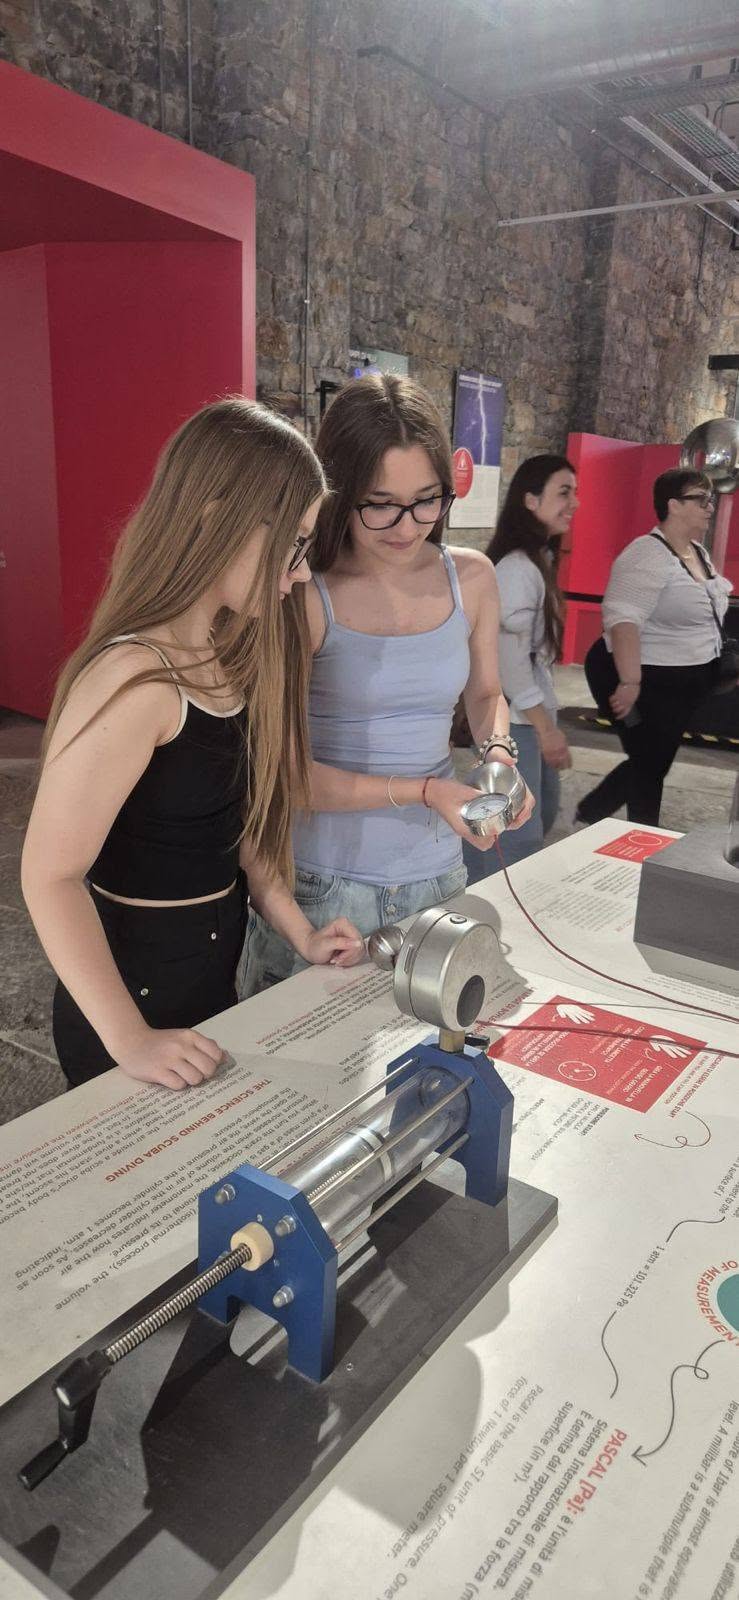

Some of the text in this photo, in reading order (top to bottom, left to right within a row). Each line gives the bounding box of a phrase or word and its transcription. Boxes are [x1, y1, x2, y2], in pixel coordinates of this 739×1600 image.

[104, 1077, 272, 1183] THE SCIENCE BEHIND SCUBA DIVING
[221, 1143, 235, 1154] the
[194, 1151, 223, 1171] volume
[162, 1169, 178, 1181] the
[174, 1175, 186, 1187] air
[185, 1169, 196, 1179] of
[193, 1172, 209, 1186] the
[131, 1178, 164, 1202] cylinder
[149, 1188, 166, 1201] the
[164, 1182, 175, 1192] in
[26, 1190, 50, 1208] body
[149, 1181, 194, 1215] manometer
[93, 1199, 132, 1227] becomes
[117, 1199, 150, 1224] cylinder
[107, 1212, 173, 1258] to its pressure.
[110, 1212, 150, 1240] indicates
[91, 1237, 112, 1254] how
[14, 1244, 63, 1279] indicating
[53, 1207, 197, 1310] (isothermal process), the volume
[55, 1252, 69, 1265] As
[73, 1251, 92, 1265] the
[647, 1250, 660, 1264] atm
[721, 1260, 738, 1272] OF
[30, 1262, 55, 1281] soon
[59, 1262, 73, 1276] air
[616, 1297, 629, 1307] Pa
[516, 1383, 544, 1414] Pascal
[510, 1411, 524, 1423] is
[720, 1399, 739, 1425] level.
[497, 1421, 516, 1440] the
[538, 1400, 574, 1446] superficie
[715, 1424, 729, 1436] A
[556, 1417, 586, 1455] definita
[478, 1438, 504, 1467] basic
[528, 1444, 546, 1461] (in
[585, 1427, 627, 1479] PASCAL
[699, 1433, 723, 1473] millibar
[386, 1374, 528, 1560] force of 1 Newton per 1 square meter.
[544, 1453, 563, 1474] dal
[721, 1457, 734, 1474] of
[688, 1481, 701, 1492] a
[692, 1470, 707, 1483] is
[452, 1479, 474, 1505] unit
[514, 1471, 551, 1519] rapporto
[565, 1478, 596, 1515] [Pa]:
[704, 1494, 719, 1508] is
[442, 1502, 457, 1520] of
[492, 1418, 608, 1591] Sistema Internazionale di misura.
[502, 1517, 522, 1538] tra
[558, 1514, 574, 1525] è
[657, 1490, 695, 1555] submultiple
[686, 1506, 712, 1547] almost
[403, 1514, 448, 1569] pressure.
[494, 1536, 511, 1550] la
[472, 1549, 502, 1583] forza
[527, 1561, 544, 1578] di
[643, 1554, 666, 1584] that
[383, 1572, 408, 1600] One
